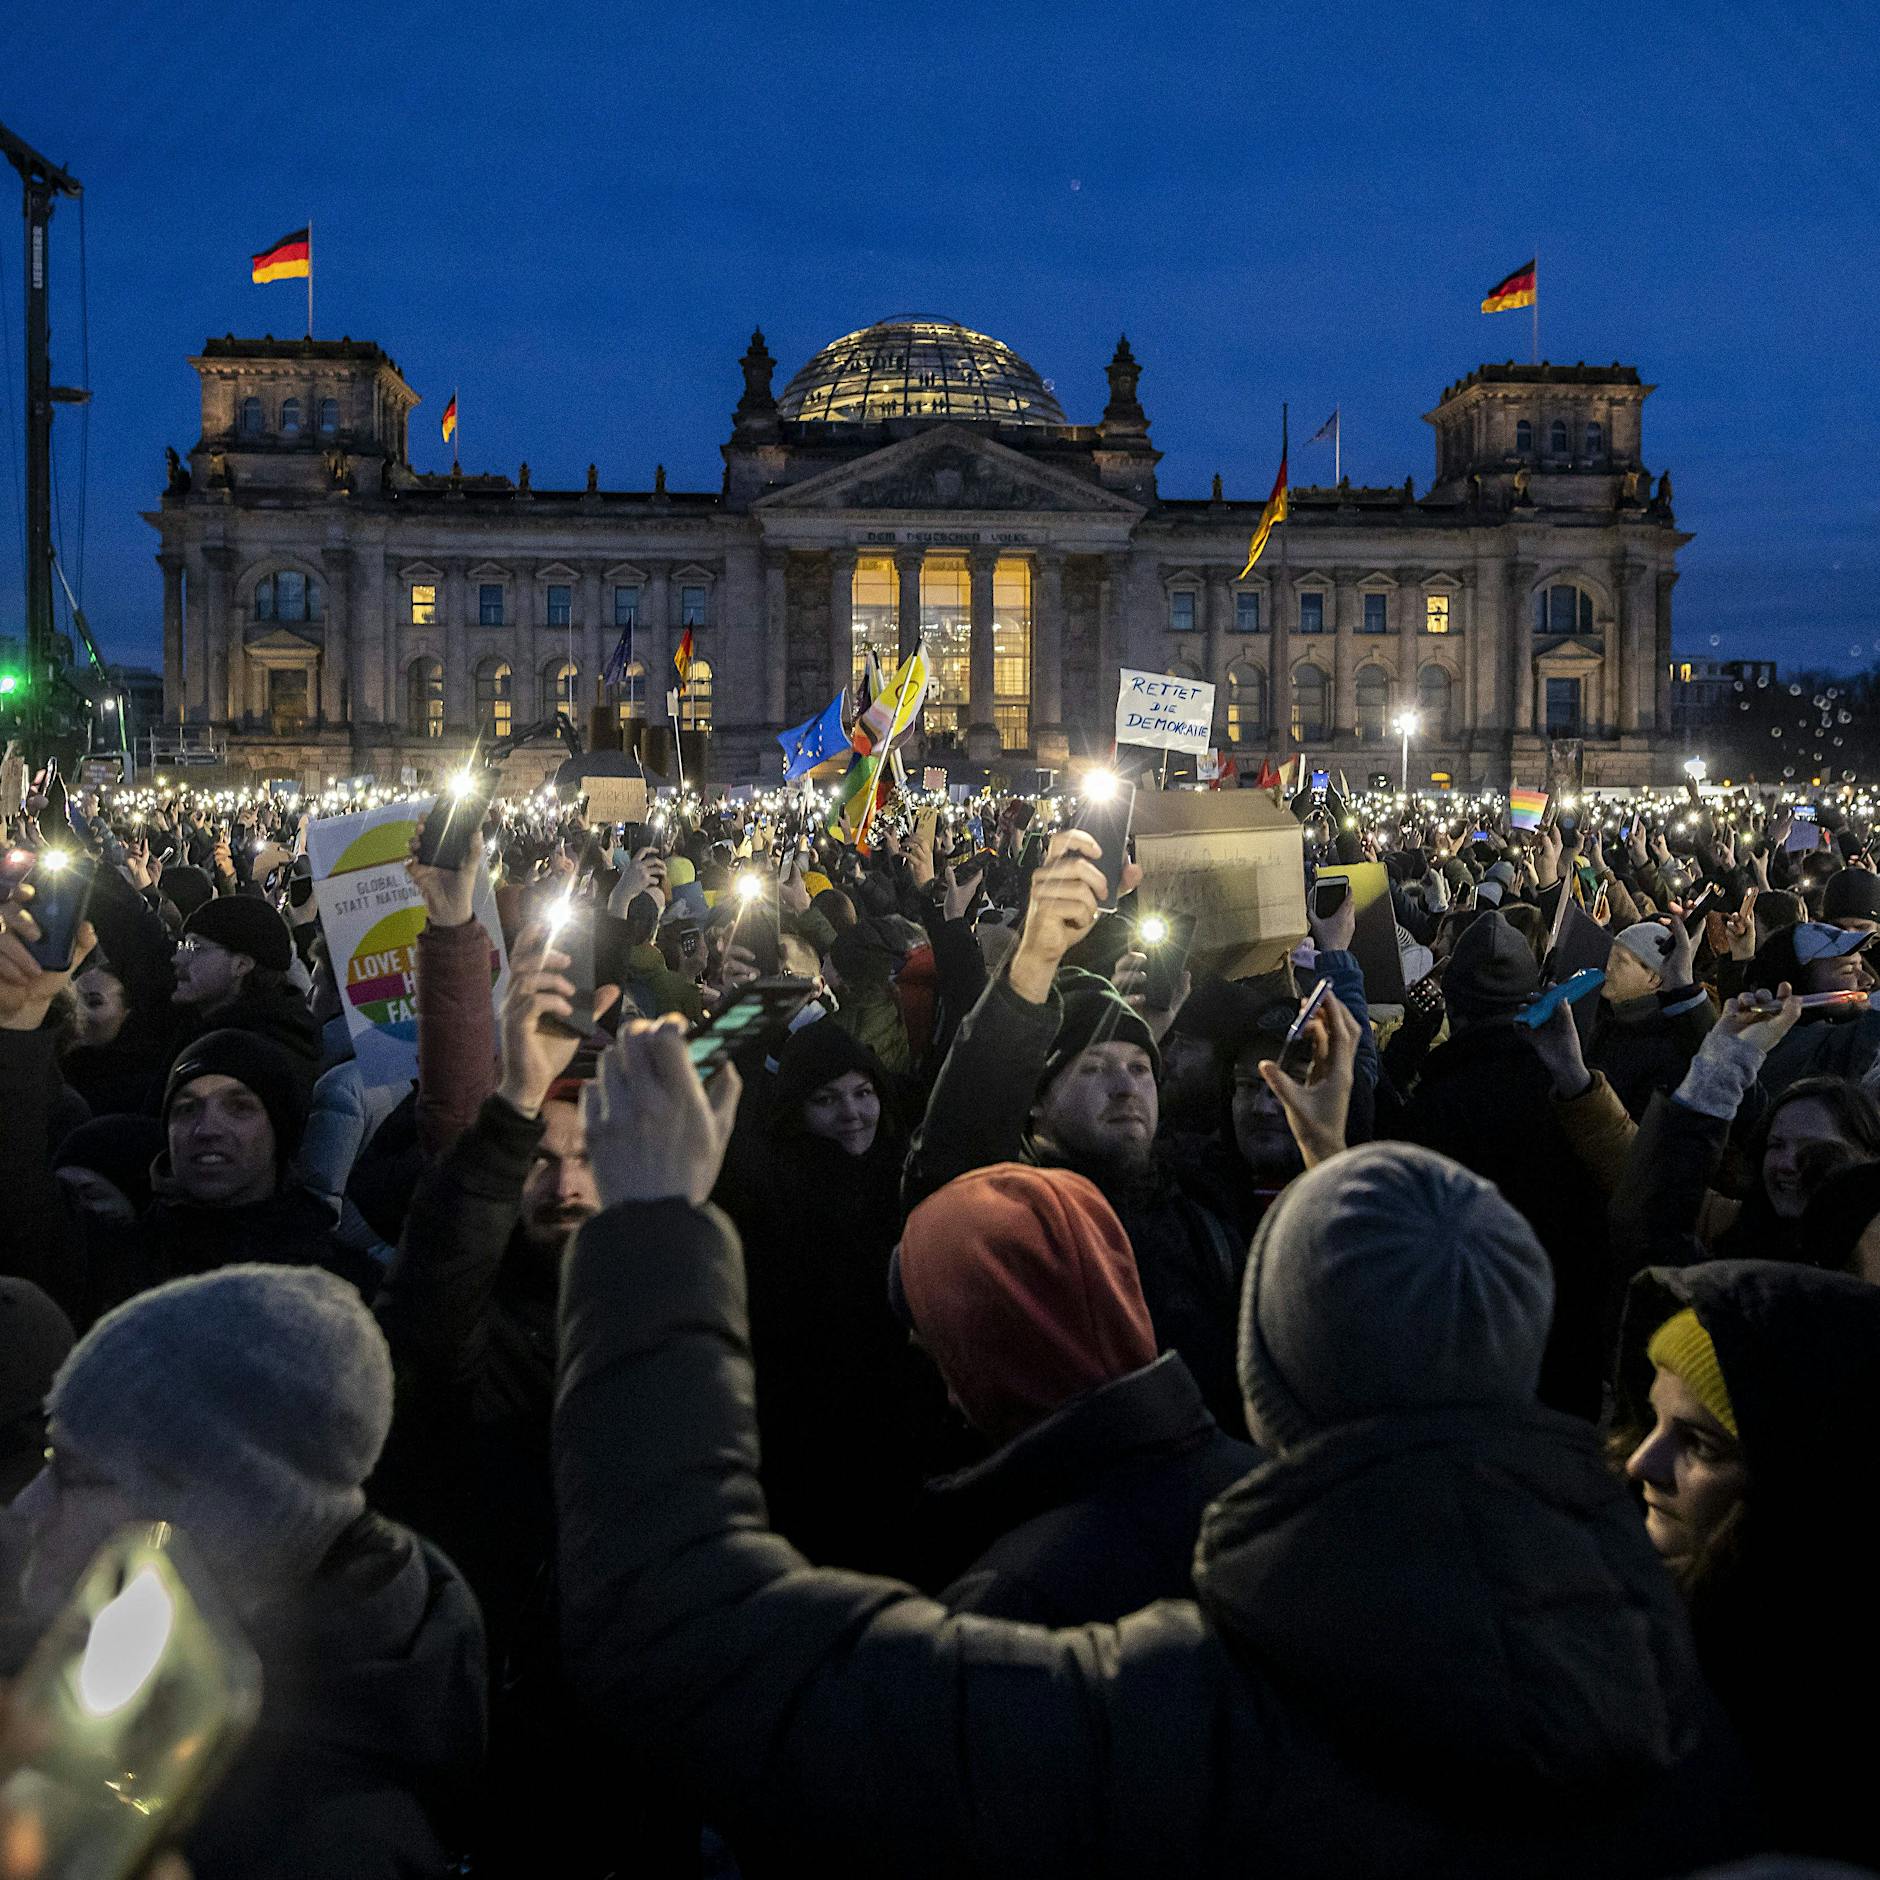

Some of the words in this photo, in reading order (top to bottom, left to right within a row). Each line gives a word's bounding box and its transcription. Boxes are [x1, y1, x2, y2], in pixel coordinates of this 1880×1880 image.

[1132, 676, 1202, 700] RETTET
[1149, 702, 1178, 714] DIE
[1126, 713, 1209, 738] DEMOKRATIE
[356, 875, 398, 894] GLOBAL
[335, 896, 370, 916] STATT
[353, 950, 402, 980] LOVE
